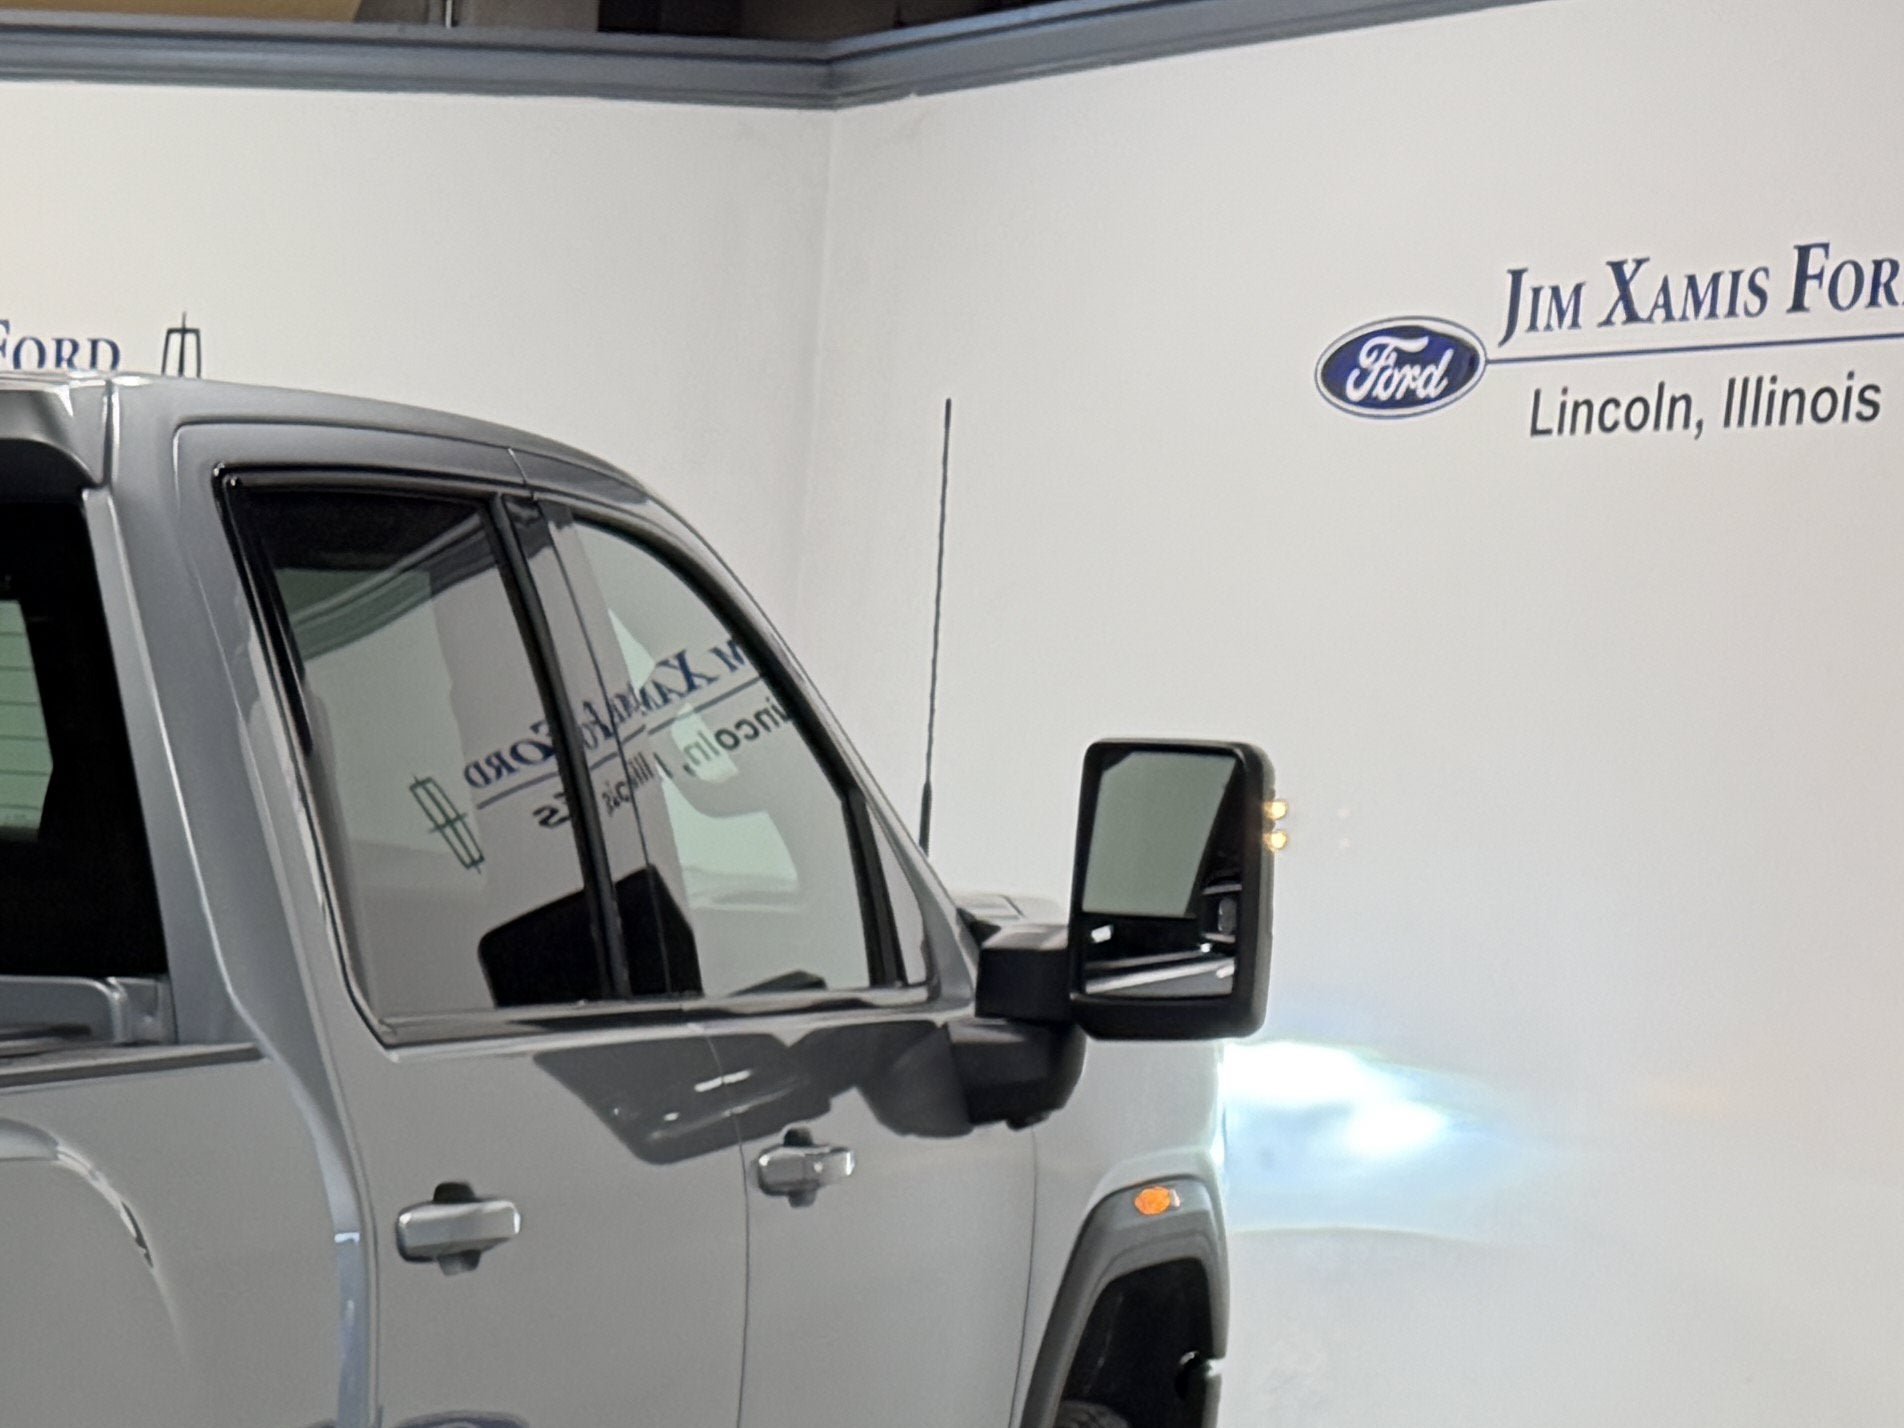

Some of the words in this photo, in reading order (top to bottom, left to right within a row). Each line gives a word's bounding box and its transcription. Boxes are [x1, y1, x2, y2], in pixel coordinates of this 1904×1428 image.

[1786, 242, 1904, 314] FOR
[1346, 336, 1455, 402] Ford
[1530, 381, 1704, 440] Lincoln,
[1723, 370, 1882, 429] Illinois
